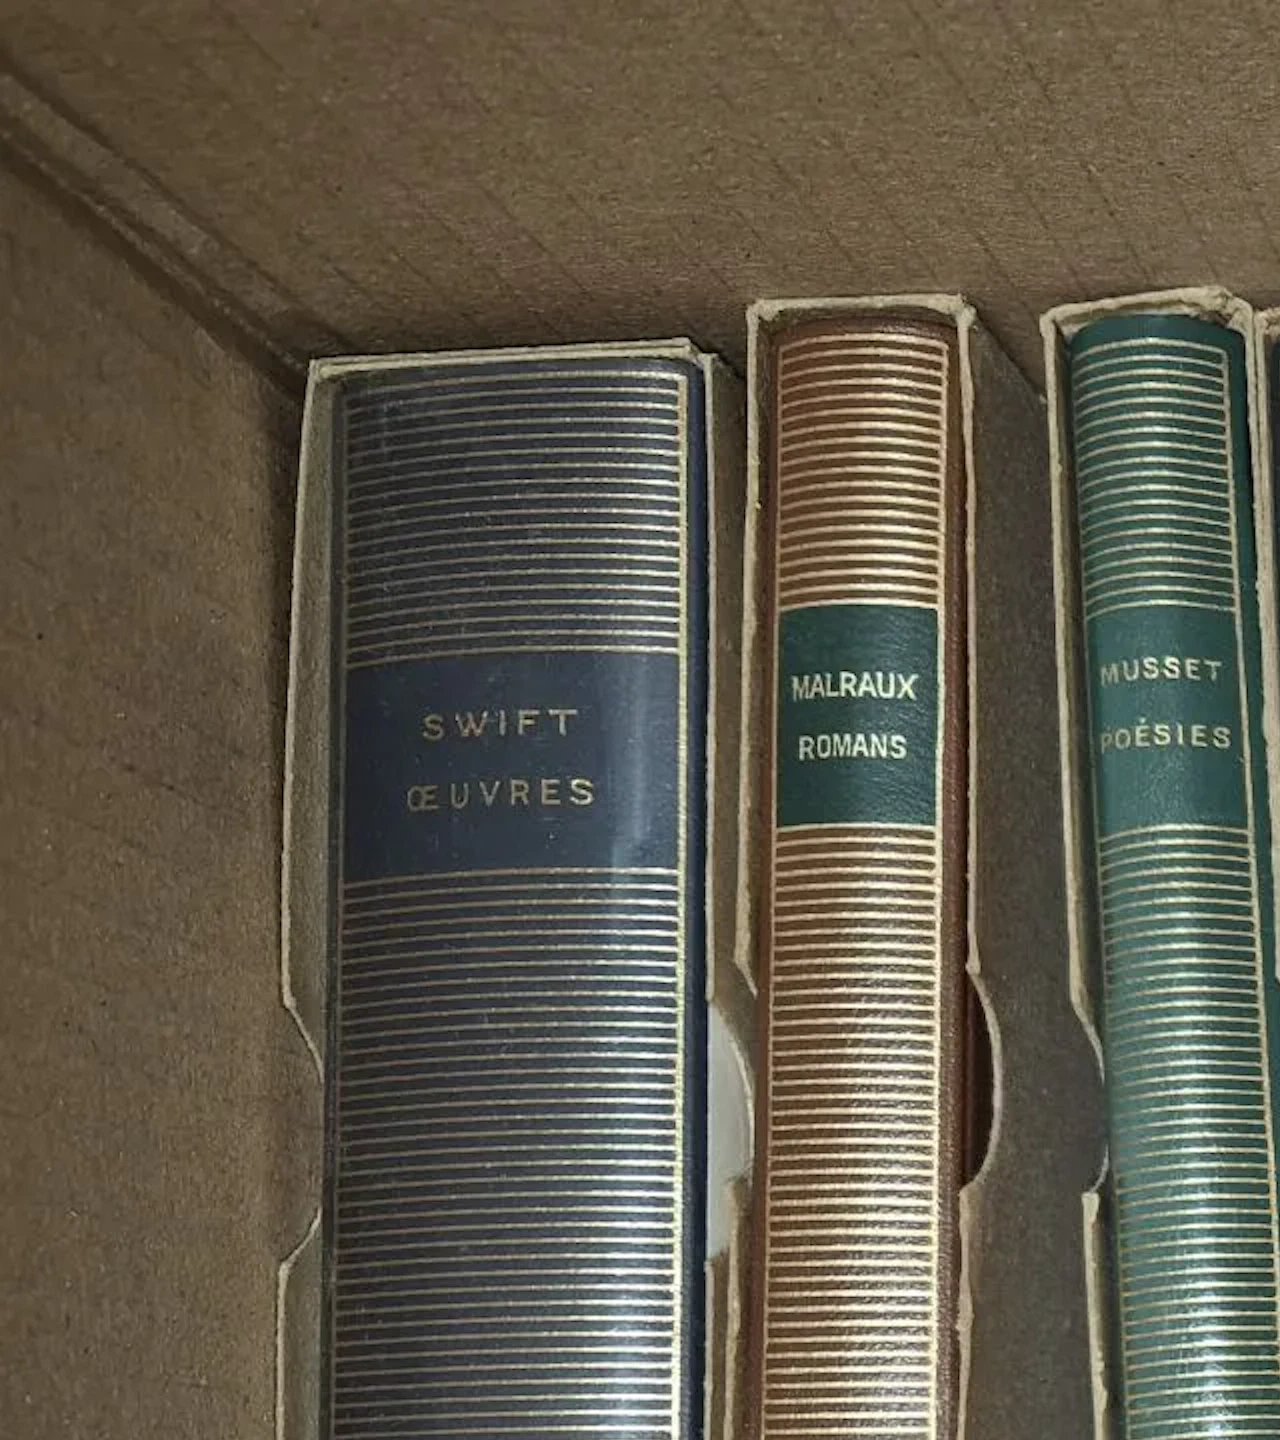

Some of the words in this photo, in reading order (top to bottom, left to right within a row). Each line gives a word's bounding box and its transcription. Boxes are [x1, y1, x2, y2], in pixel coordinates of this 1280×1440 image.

[791, 673, 919, 701] MALRAUX
[1100, 656, 1223, 687] MUSSET
[421, 708, 579, 741] SWIFT
[1100, 716, 1231, 754] POÉSIES
[798, 733, 907, 762] ROMANS
[406, 778, 596, 812] ŒUVRES
